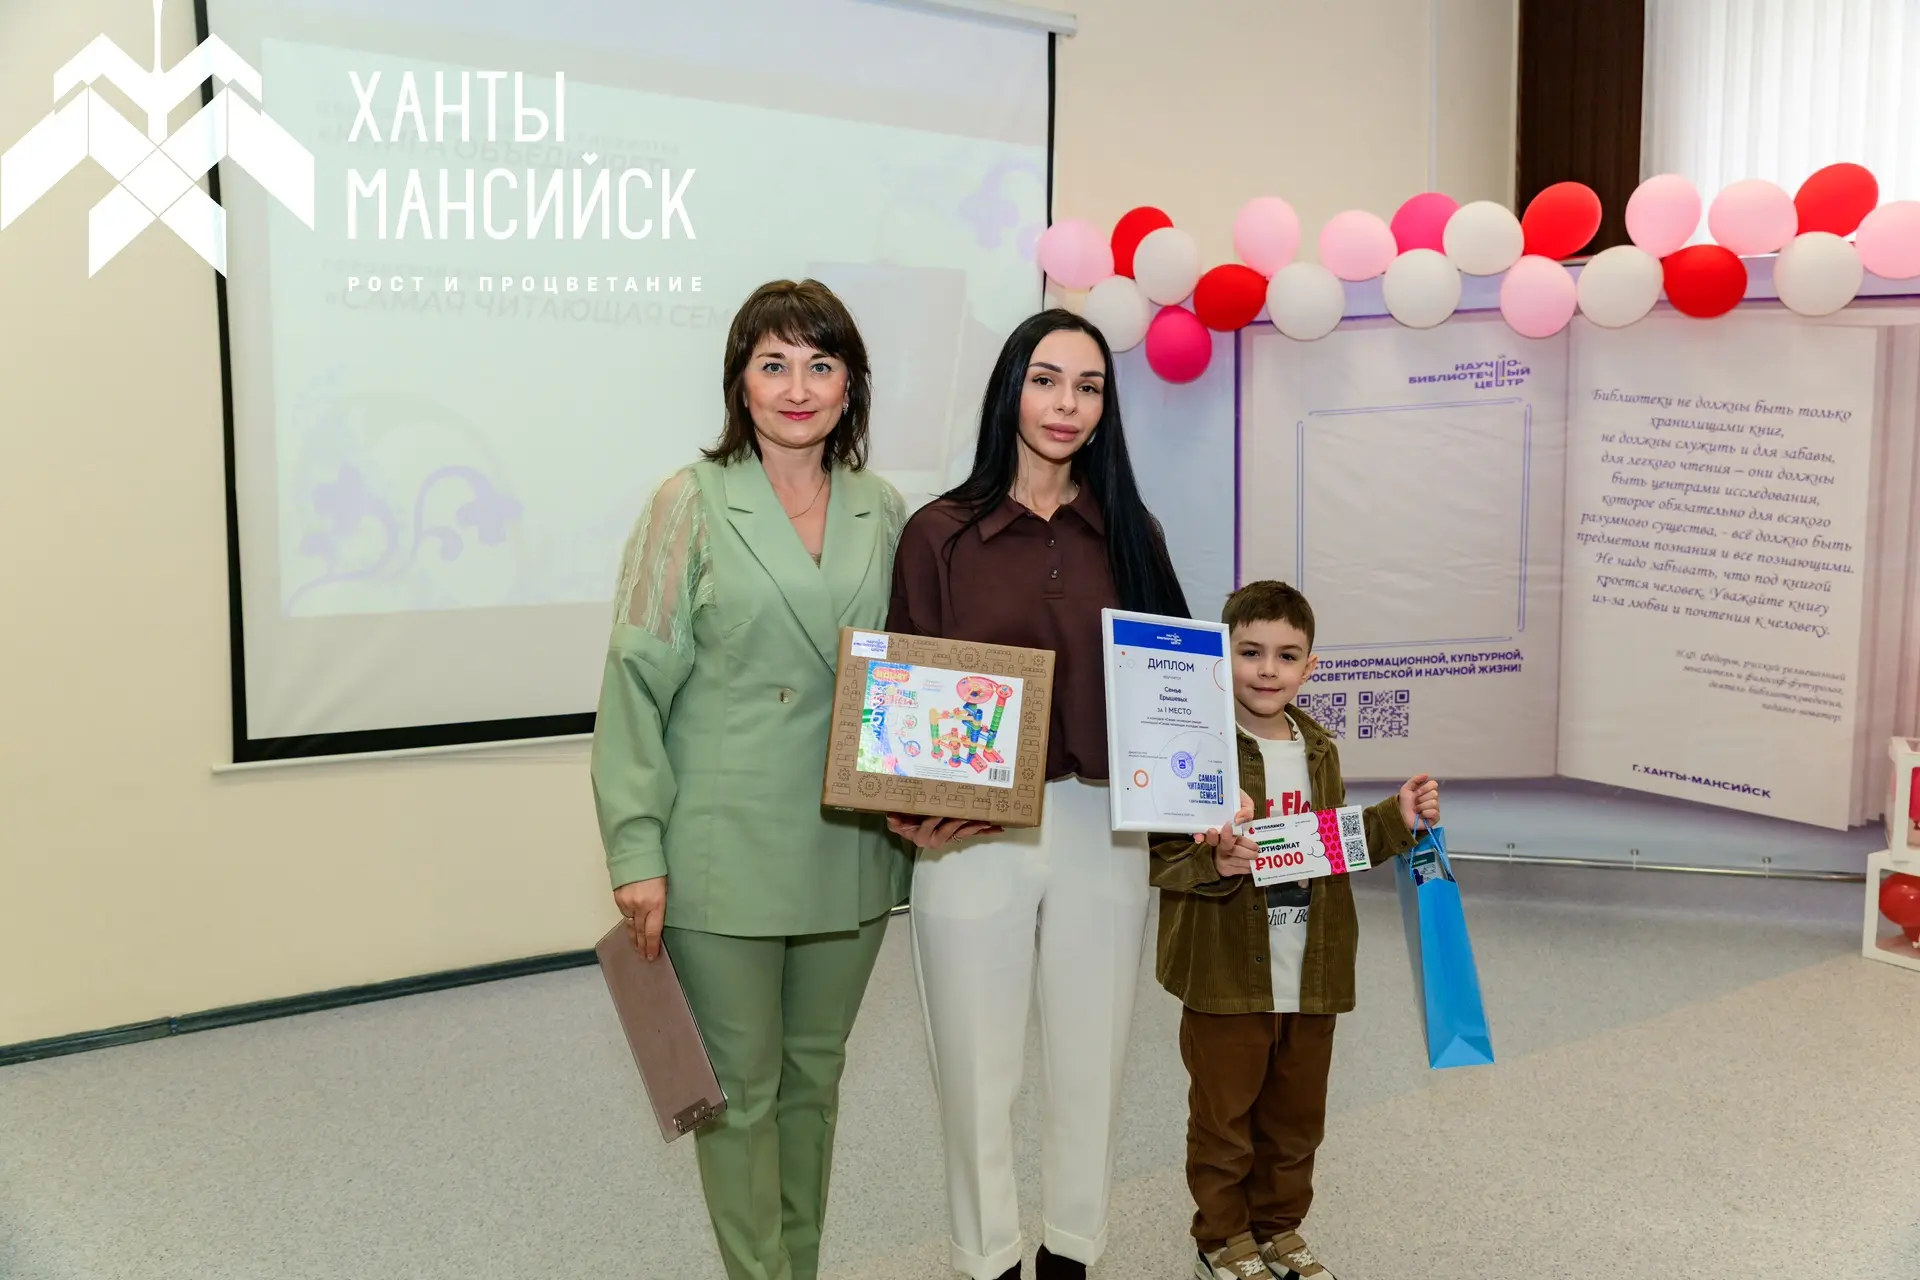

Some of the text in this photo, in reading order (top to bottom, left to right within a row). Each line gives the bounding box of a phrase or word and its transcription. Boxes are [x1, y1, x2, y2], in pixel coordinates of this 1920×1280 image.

[670, 303, 735, 329] СЕМ
[1592, 388, 1852, 423] Библиотеки не должны быть только
[1650, 417, 1784, 438] хранилищами книг,
[1601, 430, 1835, 463] не должны служить и для забавы,
[1601, 450, 1624, 464] для
[1680, 460, 1730, 475] чтения
[1748, 467, 1773, 479] они
[1777, 467, 1834, 486] должны
[1611, 471, 1647, 487] быть
[1651, 479, 1720, 495] центрами
[1602, 494, 1831, 528] которое обязательно для всякого
[1576, 531, 1650, 549] предметом
[1654, 541, 1716, 558] познания
[1721, 549, 1729, 559] и
[1580, 512, 1649, 527] разумного
[1755, 529, 1808, 548] должно
[1811, 534, 1852, 552] быть
[1595, 551, 1613, 564] Не
[1617, 556, 1646, 569] надо
[1723, 570, 1750, 582] что
[1754, 572, 1779, 585] под
[1782, 578, 1831, 592] книгой
[1592, 593, 1625, 606] из-за
[1628, 596, 1668, 611] любви
[1672, 607, 1680, 616] и
[1685, 607, 1751, 624] почтения
[1754, 616, 1766, 629] к
[1596, 575, 1649, 590] кроется
[1709, 587, 1784, 607] Уважайте
[1788, 600, 1830, 617] книгу
[1148, 658, 1194, 672] ДИПЛОМ
[1307, 663, 1522, 683] ОСВЕТИТЕЛЬСКОЙ И НАУЧНОЙ ЖИЗНИ!
[1335, 653, 1448, 670] ИНФОРМАЦИОННОЙ,
[1450, 649, 1524, 664] КУЛЬТУРНОЙ,
[1168, 707, 1192, 715] МЕСТО
[1643, 766, 1771, 799] ХАНТЫ-МАНСИЙСК
[1257, 841, 1300, 854] ЕРТИФИКАТ
